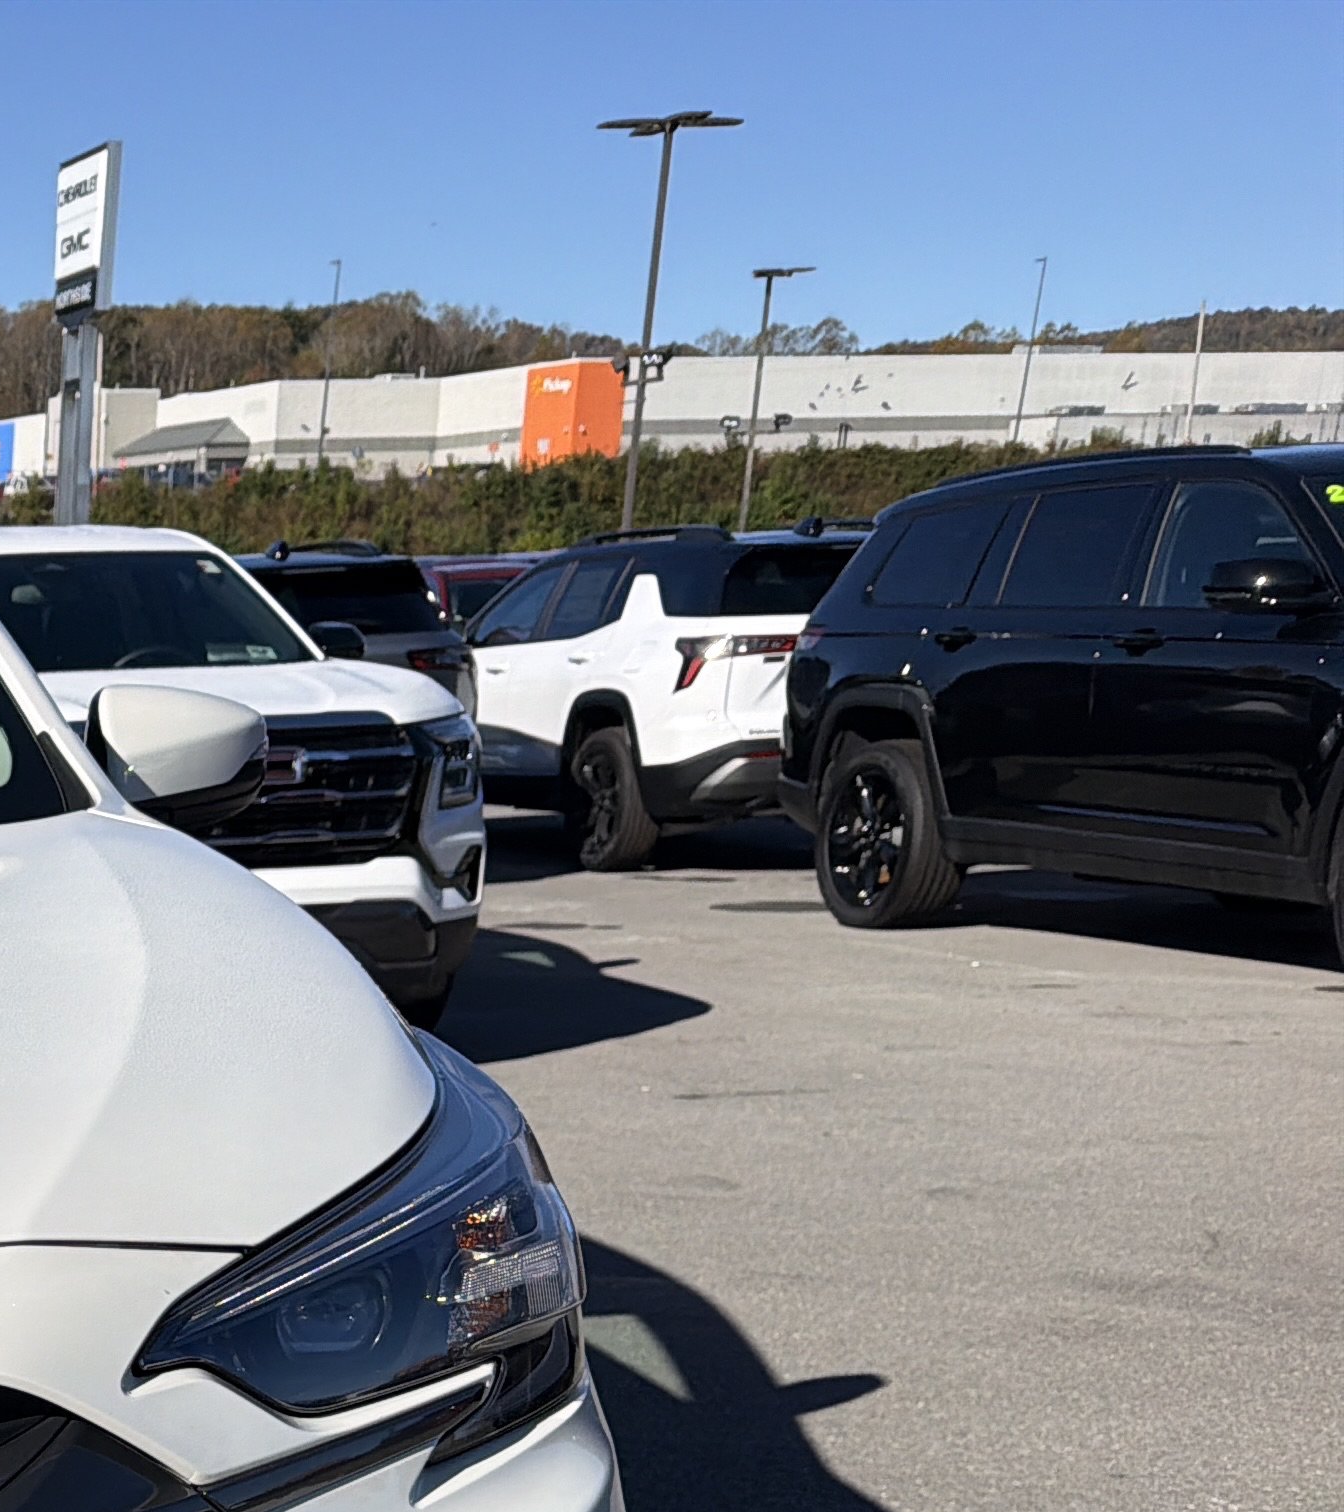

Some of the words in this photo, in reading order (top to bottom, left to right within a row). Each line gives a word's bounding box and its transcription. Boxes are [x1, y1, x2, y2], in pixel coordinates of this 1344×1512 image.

[57, 173, 98, 208] CHEVROLET
[60, 227, 91, 259] GMC
[543, 377, 572, 394] Pickup
